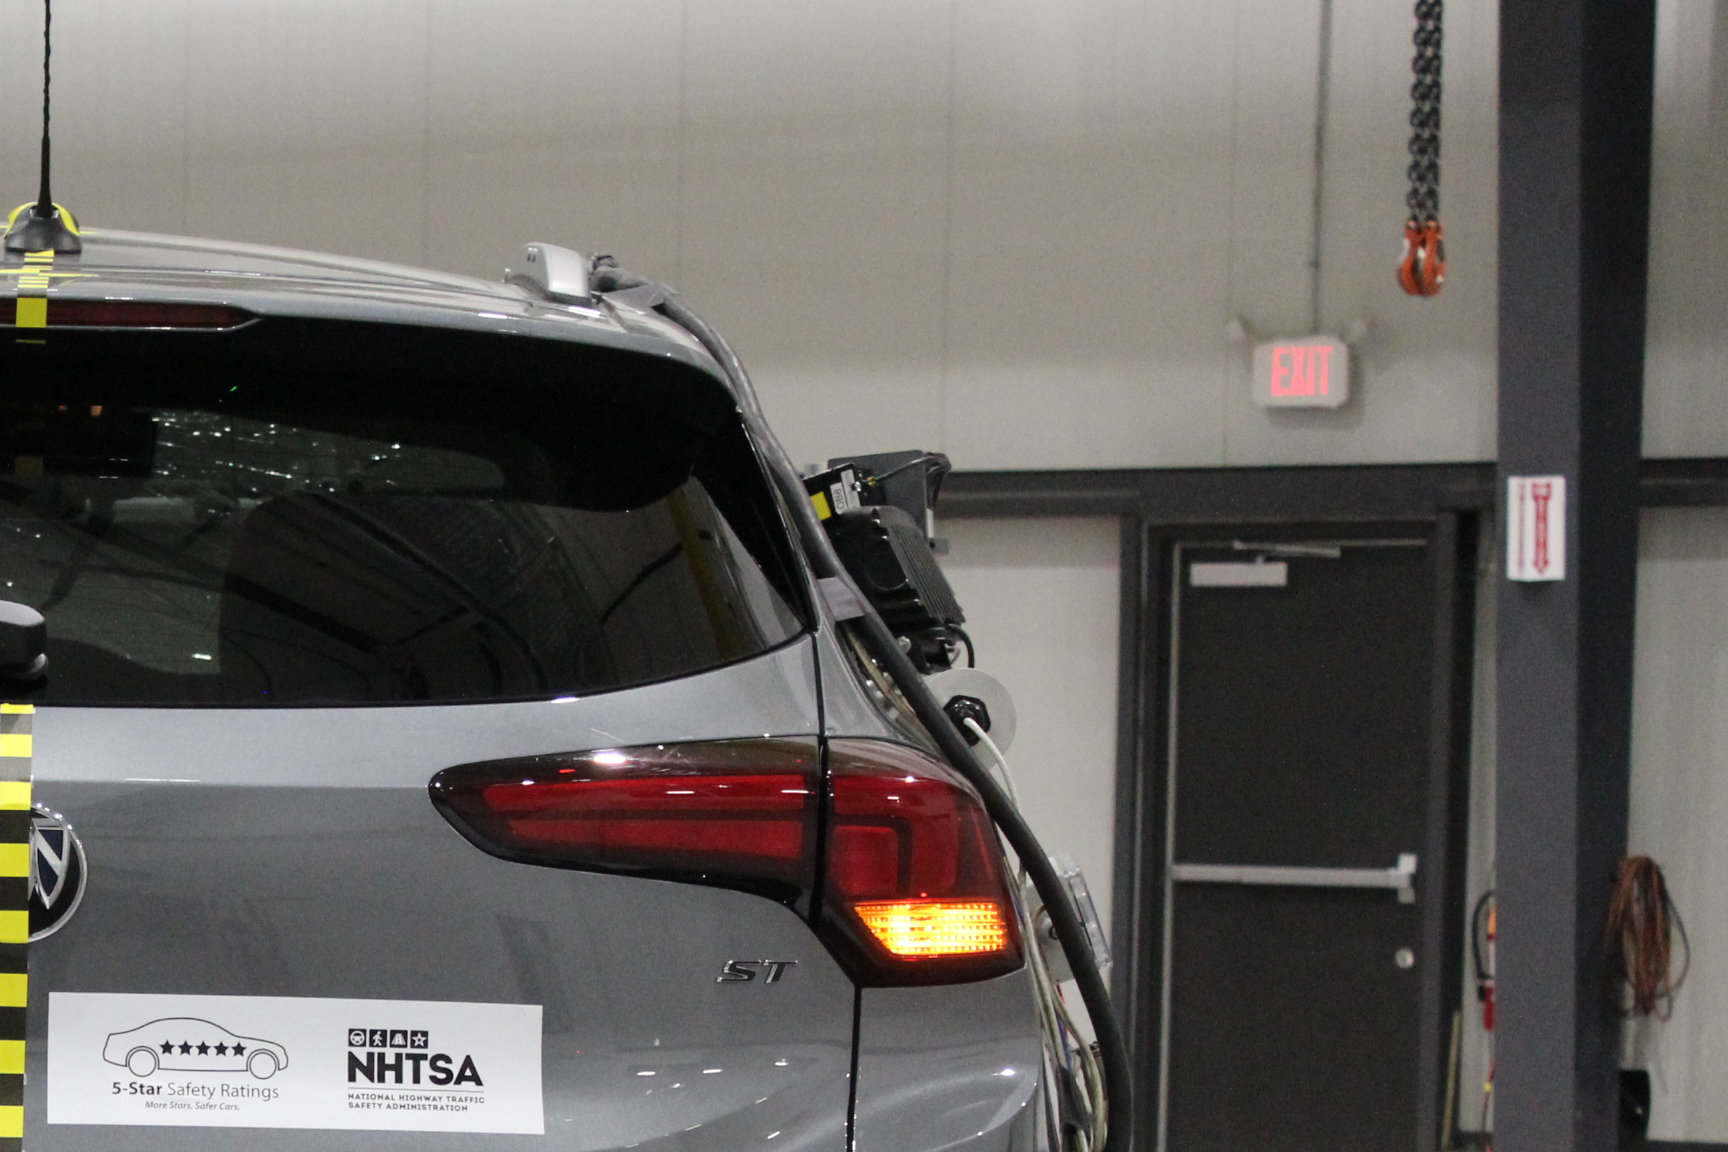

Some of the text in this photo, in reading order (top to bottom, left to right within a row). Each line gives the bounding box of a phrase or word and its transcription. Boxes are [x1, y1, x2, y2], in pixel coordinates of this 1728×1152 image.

[1271, 345, 1333, 396] EXIT
[715, 959, 798, 984] ST
[348, 1052, 484, 1087] NHTSA
[112, 1082, 279, 1101] 5-Star Safety Ratings
[348, 1093, 485, 1104] NATIONAL HIGHWAY TRAFFIC
[145, 1101, 240, 1111] More Stars. Safer Cars.
[386, 1103, 468, 1112] ADMINISTRATION
